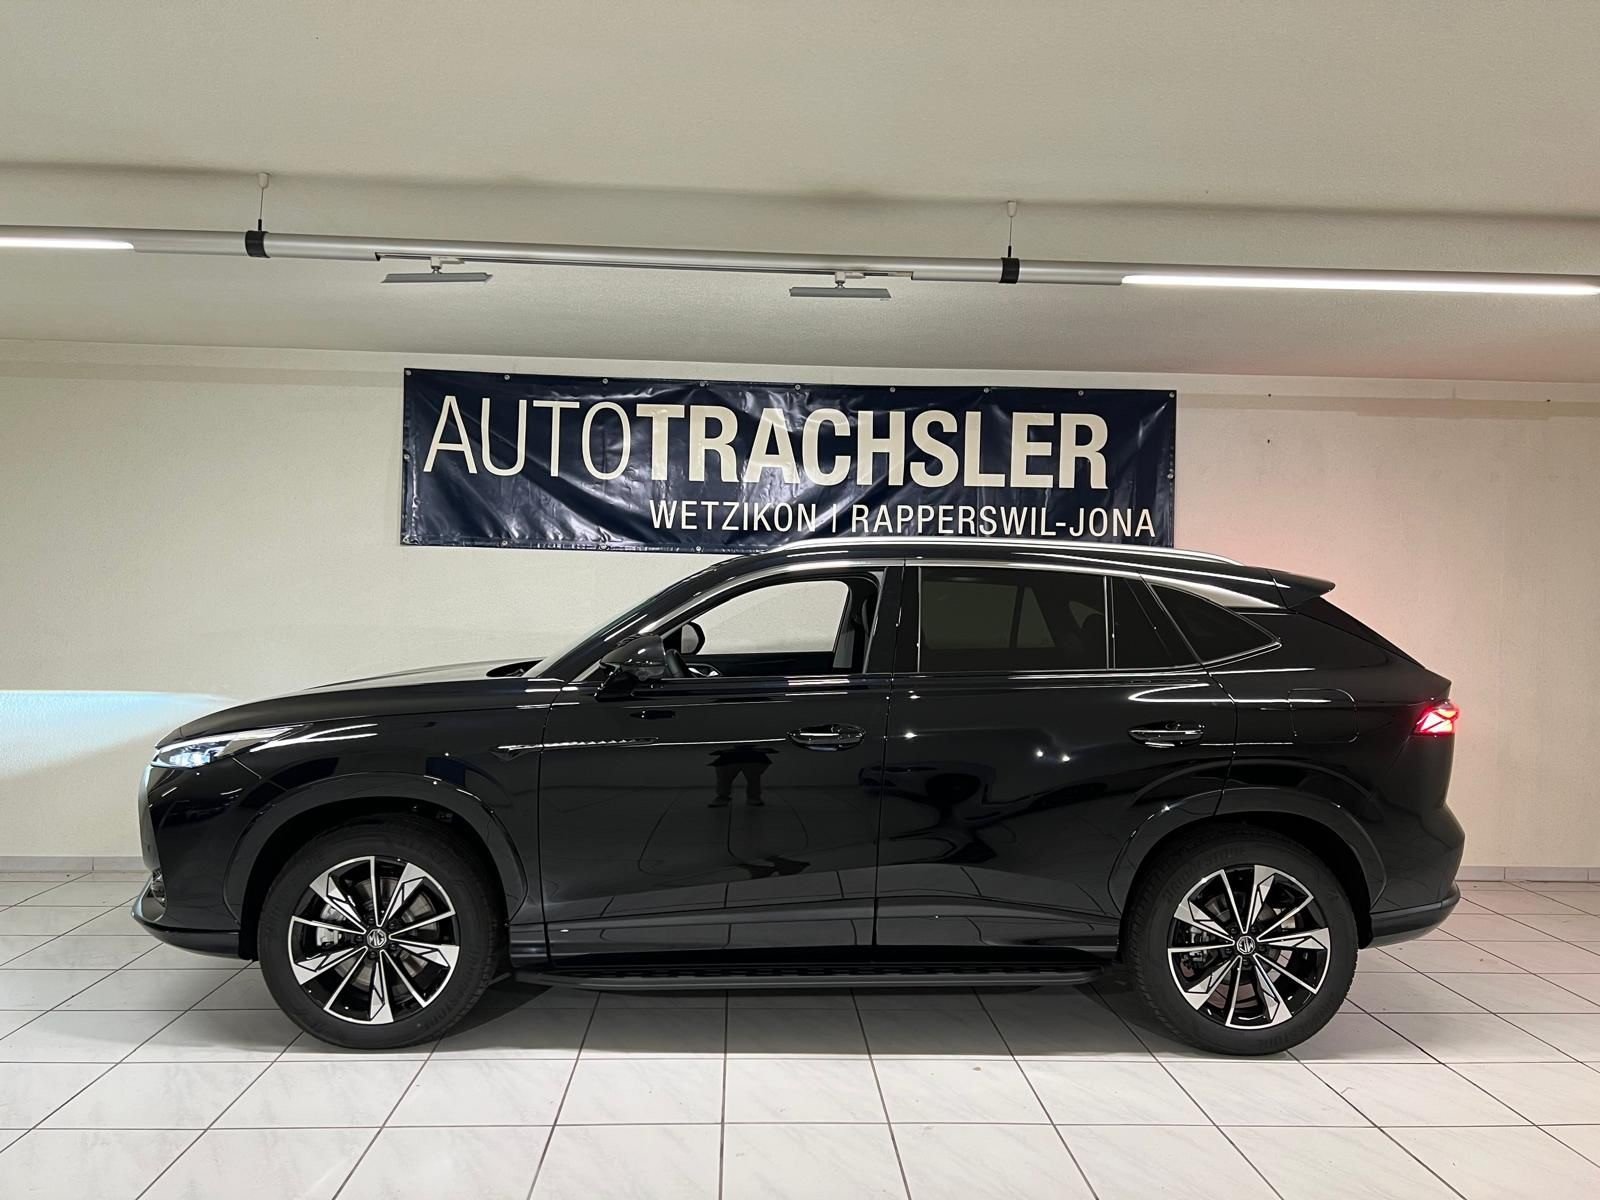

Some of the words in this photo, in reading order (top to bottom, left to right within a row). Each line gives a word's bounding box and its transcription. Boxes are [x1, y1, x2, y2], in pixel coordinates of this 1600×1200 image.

[423, 395, 1109, 490] AUTOTRACHSLER
[649, 500, 817, 532] WETZIKON
[851, 504, 1156, 538] RAPPERSWIL-JONA
[369, 931, 385, 947] MG
